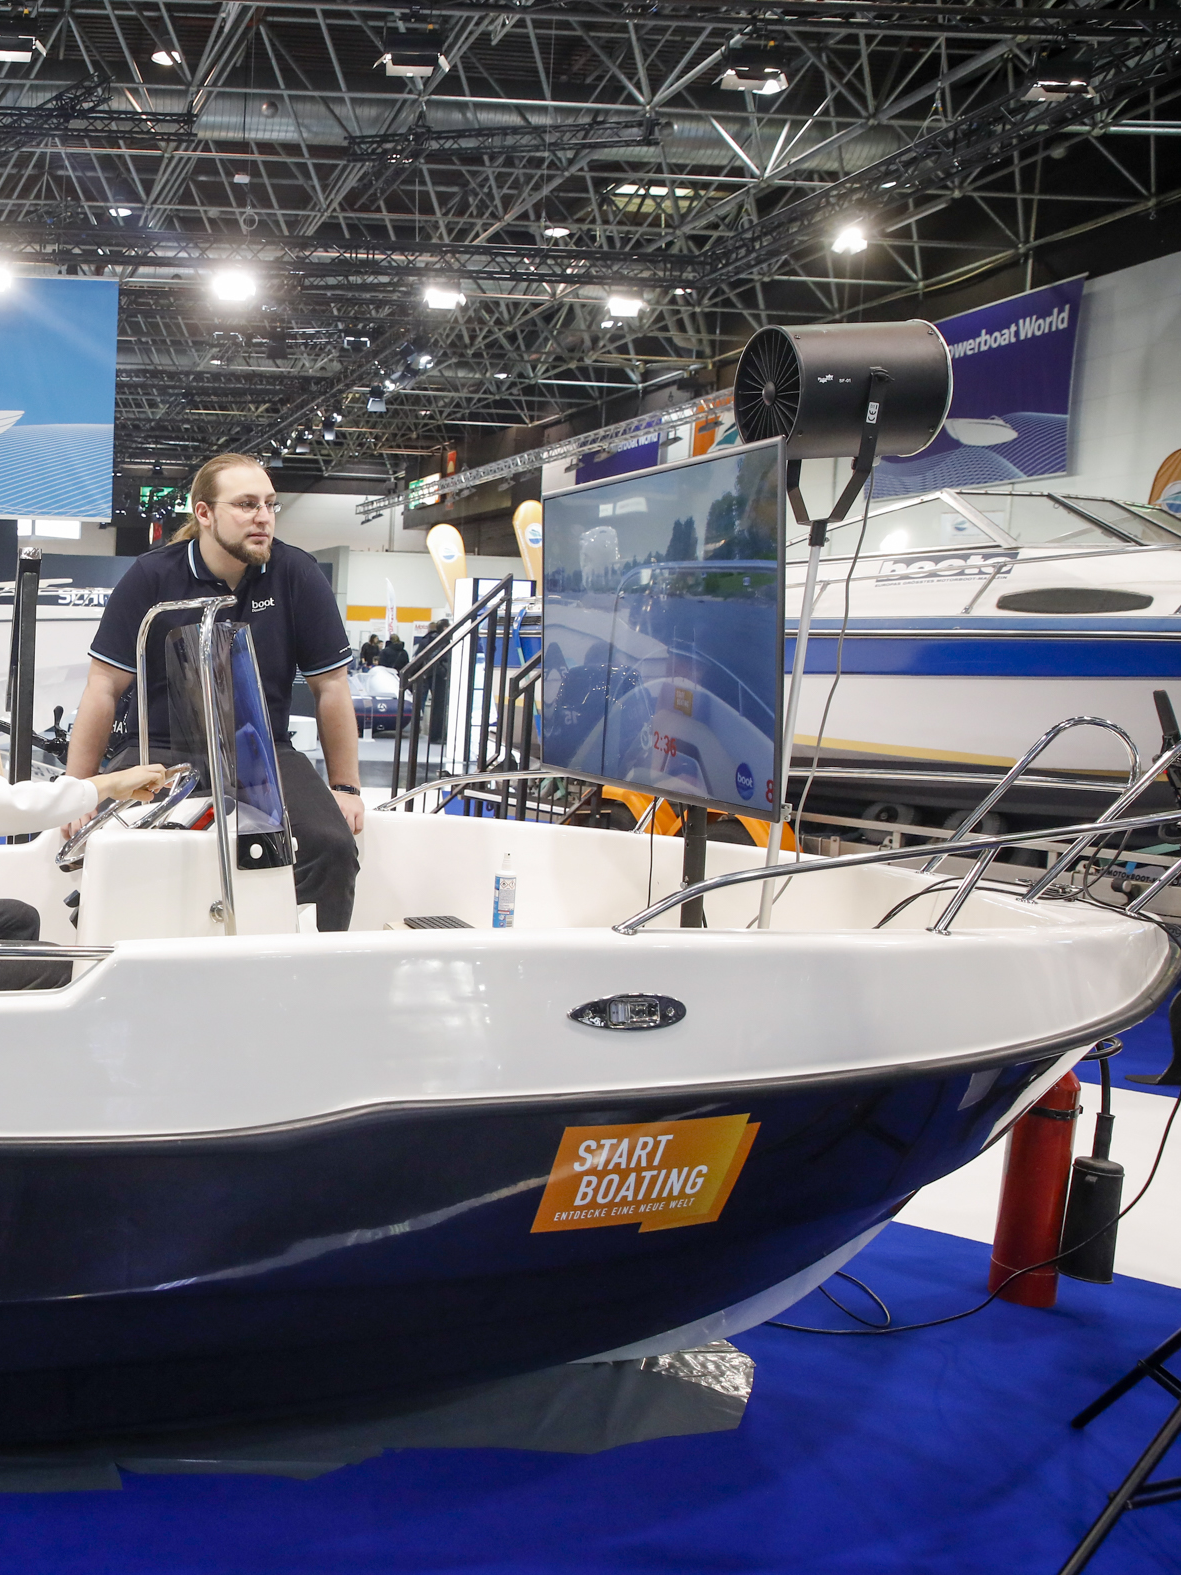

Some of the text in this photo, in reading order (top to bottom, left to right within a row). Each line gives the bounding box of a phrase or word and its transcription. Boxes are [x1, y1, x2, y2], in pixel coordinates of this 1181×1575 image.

[949, 304, 1071, 360] owerboat World
[251, 597, 275, 609] boot
[653, 731, 678, 757] 2:36
[737, 772, 754, 788] boot
[573, 1134, 674, 1172] START
[573, 1164, 709, 1206] BOATING
[553, 1197, 696, 1222] ENTDECKE EINE NEUE WELT
